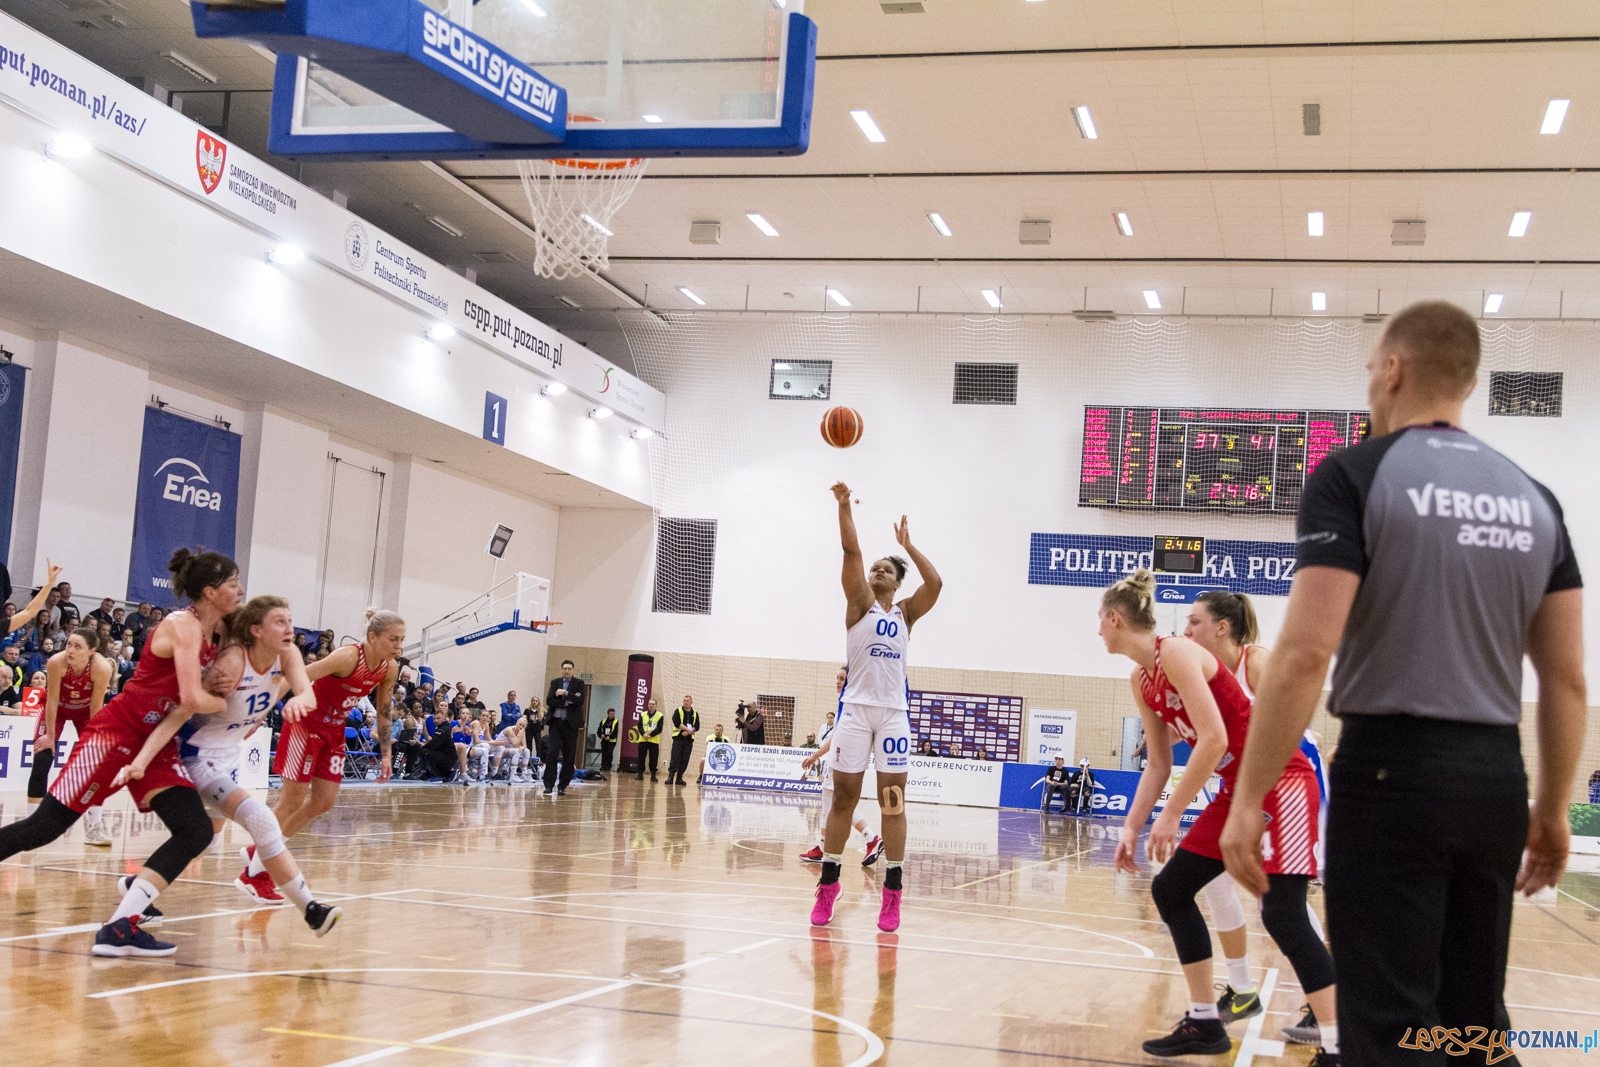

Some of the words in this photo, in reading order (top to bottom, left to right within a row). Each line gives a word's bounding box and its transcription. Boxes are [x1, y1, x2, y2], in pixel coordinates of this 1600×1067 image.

[230, 164, 259, 190] SAMORZĄD
[260, 180, 297, 211] WOJEWÓDZTWA
[229, 179, 276, 214] WIELKOPOLSKIEGO
[376, 240, 404, 268] Centrum
[406, 257, 427, 280] Sportu
[374, 261, 412, 293] Politechniki
[413, 282, 449, 315] Poznańskiej
[464, 299, 563, 369] cspp.put.poznan.pl
[492, 401, 500, 438] 1
[1194, 433, 1219, 449] 37
[1228, 441, 1234, 449] 3
[1250, 435, 1275, 450] 41
[1298, 438, 1304, 446] 3
[1176, 459, 1183, 468] 2
[1296, 463, 1302, 471] 4
[162, 473, 222, 511] Enea
[1407, 482, 1532, 527] VERONI
[1457, 524, 1534, 552] active
[1162, 592, 1186, 600] Enea
[464, 627, 500, 641] PESMENPOL
[876, 618, 898, 638] 00
[869, 648, 901, 659] Enea
[25, 689, 41, 707] 5
[70, 690, 81, 699] 5
[633, 679, 648, 720] Energa
[245, 691, 271, 716] 13
[883, 737, 908, 754] 00
[911, 760, 993, 773] KONFERENCYJNE
[705, 775, 742, 785] Wybierz
[743, 778, 775, 788] zawód
[906, 780, 943, 788] NOVOTEL
